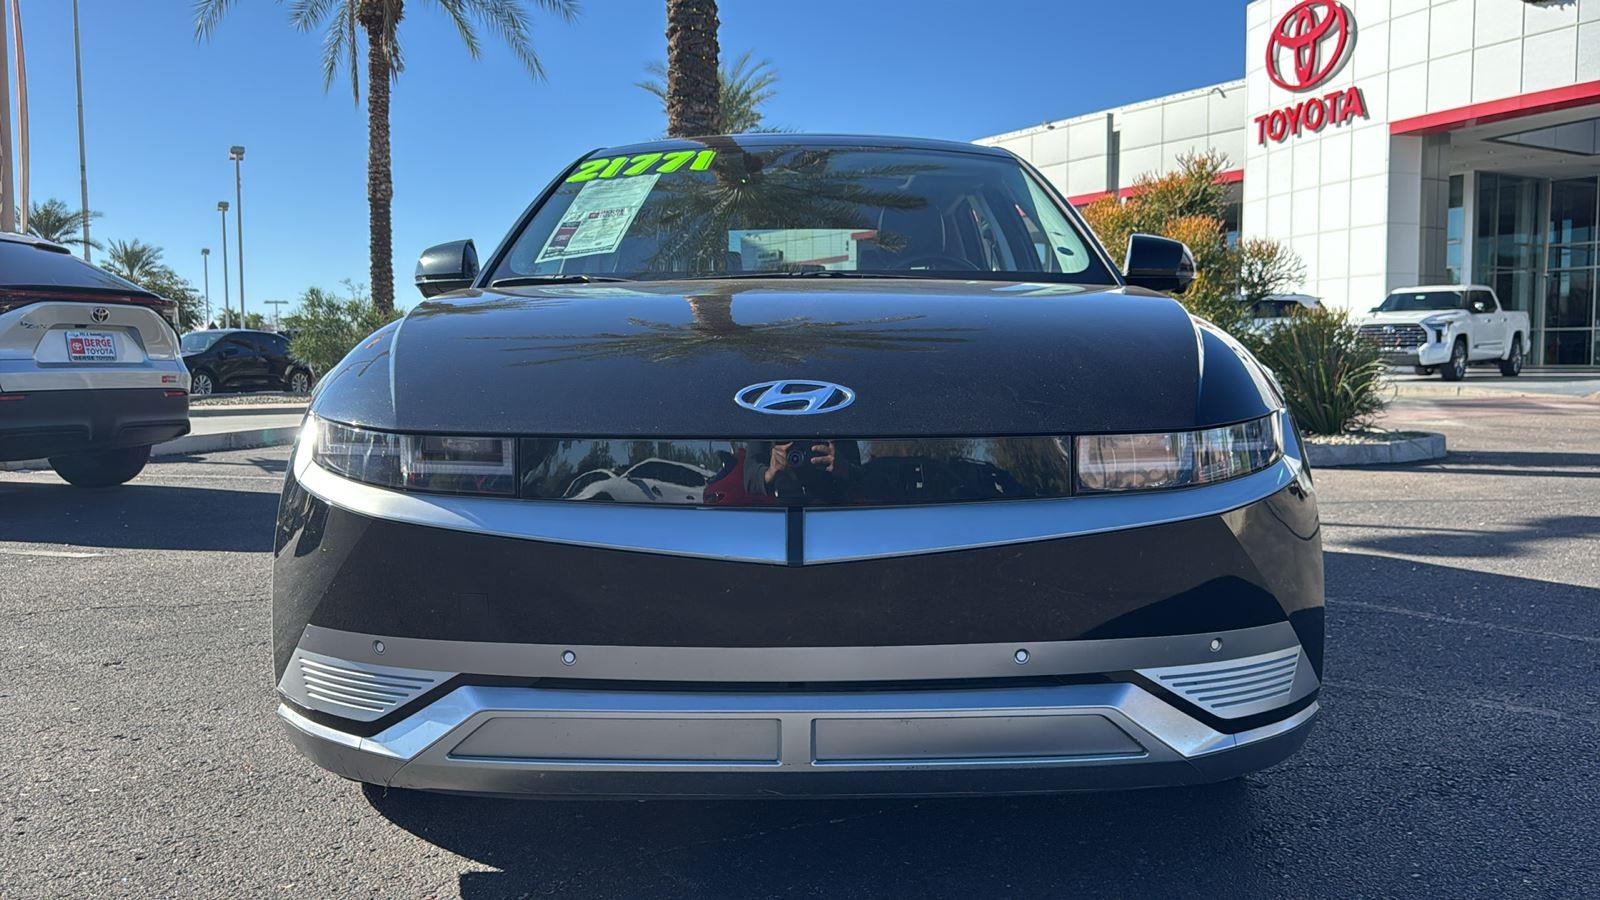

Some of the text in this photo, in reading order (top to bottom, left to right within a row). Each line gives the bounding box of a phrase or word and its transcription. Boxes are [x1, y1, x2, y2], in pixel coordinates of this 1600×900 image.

[1254, 86, 1365, 145] TOYOTA
[565, 150, 716, 182] 21771
[84, 338, 112, 348] BERGE
